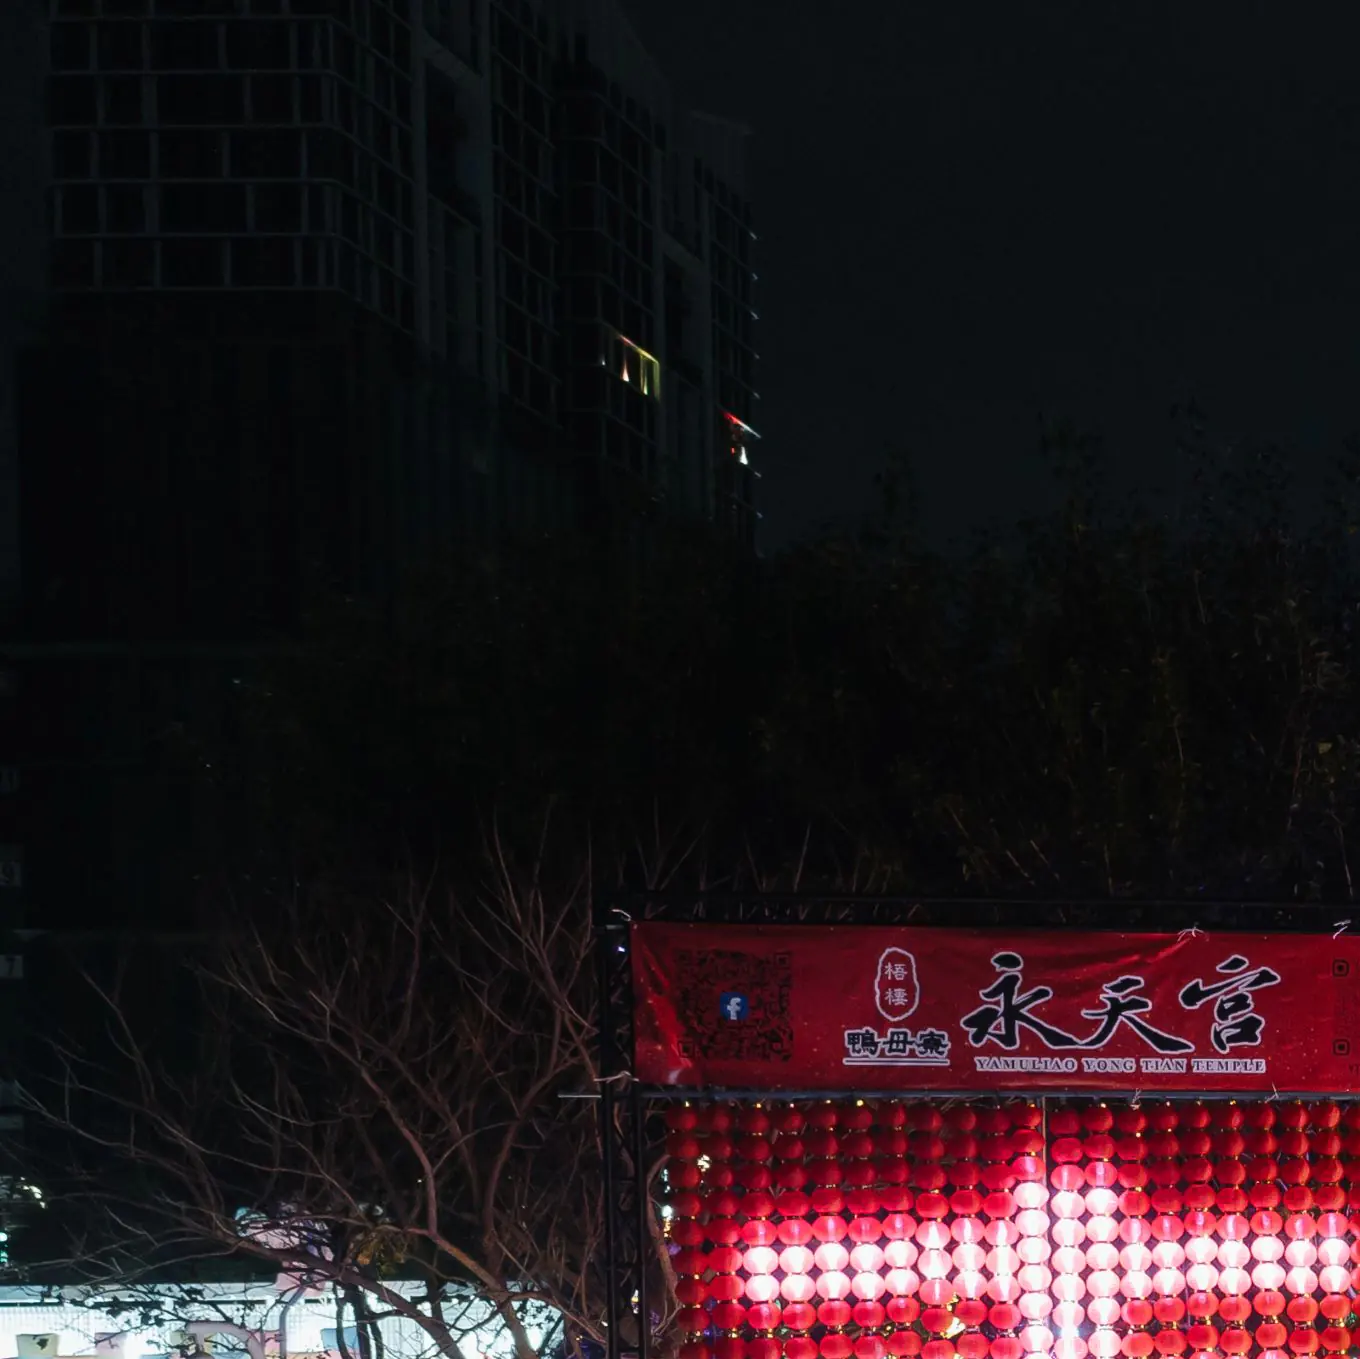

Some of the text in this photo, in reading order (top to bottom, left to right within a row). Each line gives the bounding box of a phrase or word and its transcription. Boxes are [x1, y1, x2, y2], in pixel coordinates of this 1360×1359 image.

[884, 961, 909, 1006] 梧棲
[960, 951, 1281, 1054] 永天宮
[844, 1027, 952, 1059] 鴨母寮
[974, 1056, 1267, 1074] YAMULIAO YONG TIAN TEMPLE
